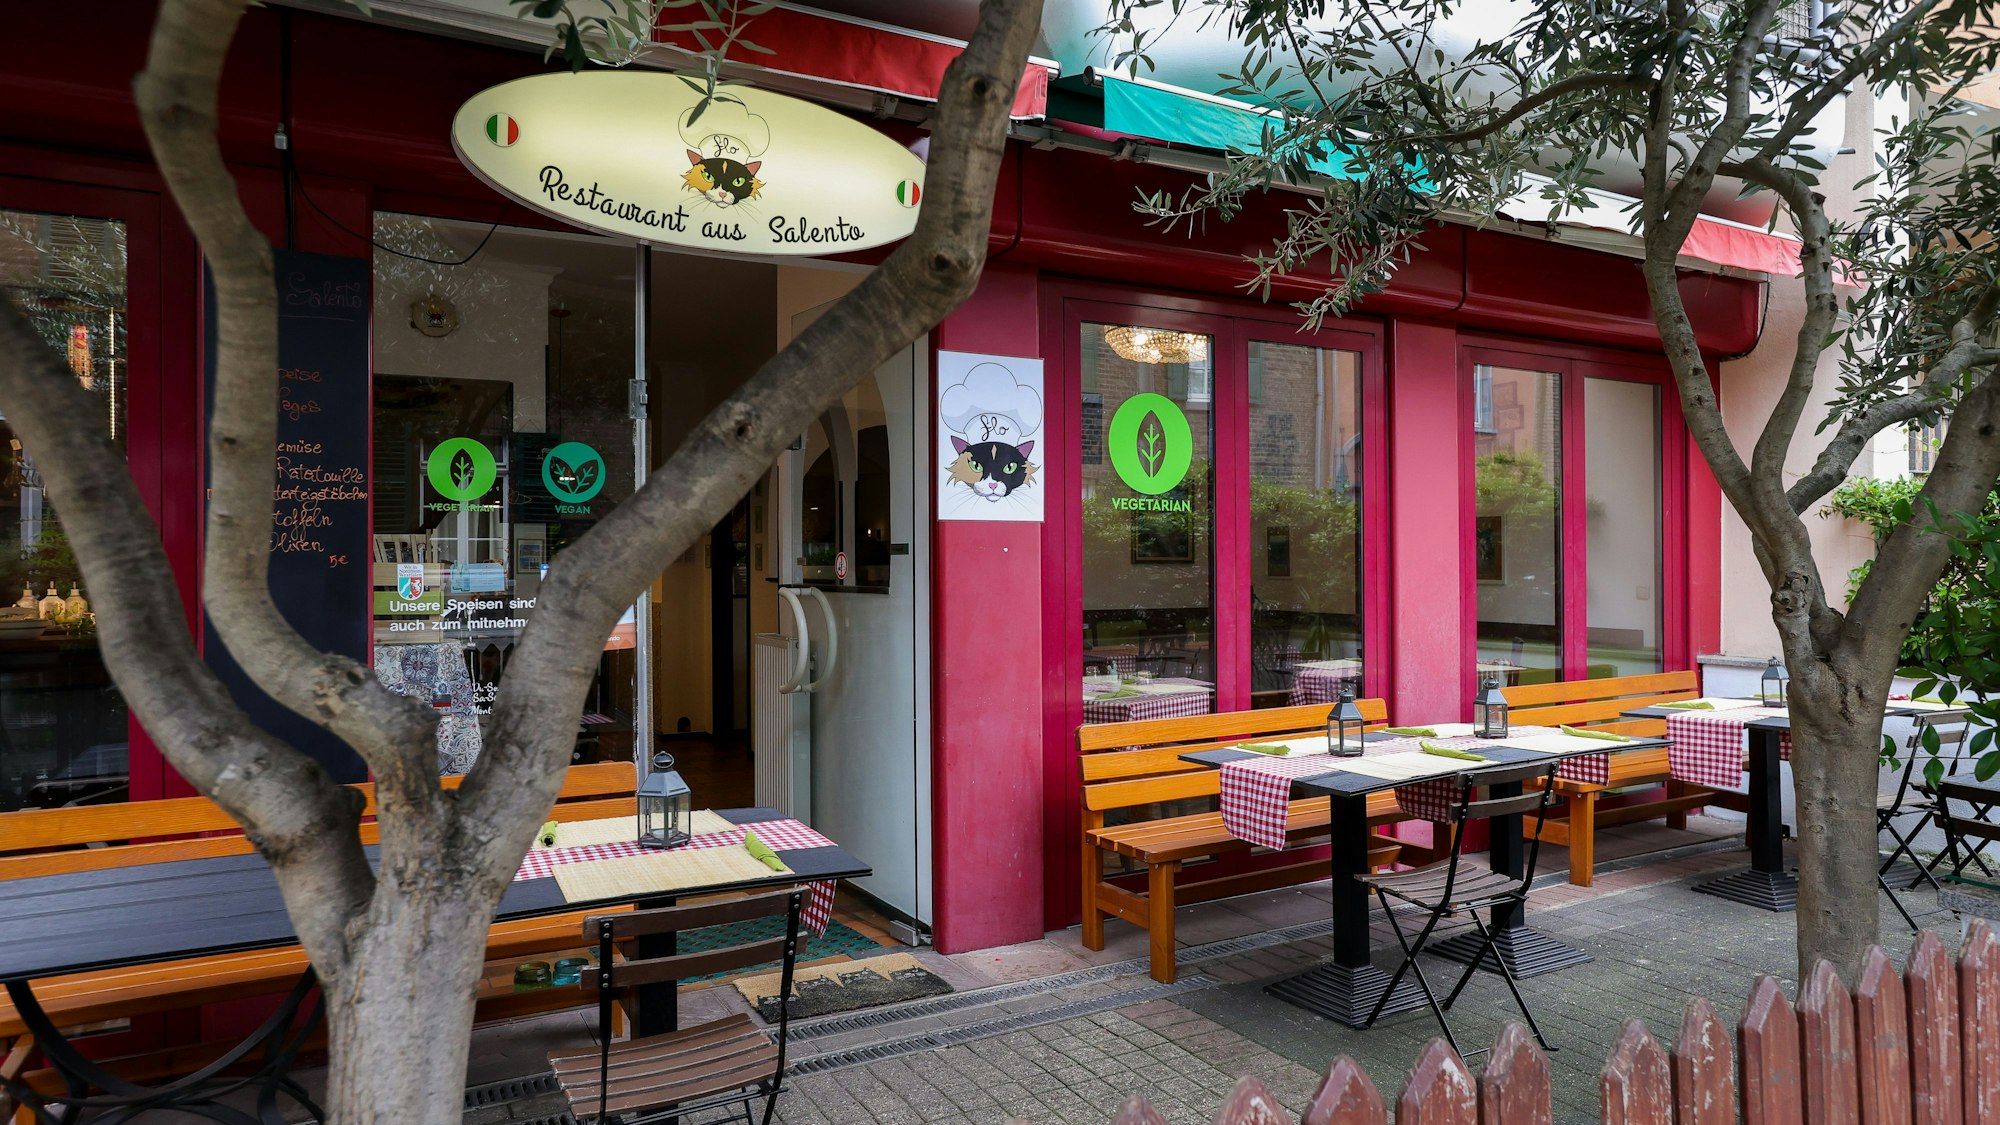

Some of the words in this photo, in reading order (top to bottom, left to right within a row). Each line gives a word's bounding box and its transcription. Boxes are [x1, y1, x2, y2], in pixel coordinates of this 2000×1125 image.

[539, 165, 691, 233] Restaurant
[702, 220, 747, 241] aus
[769, 216, 865, 244] Salento
[286, 272, 362, 309] Salento
[276, 439, 322, 454] emüse
[272, 484, 368, 511] terteigstäbchen
[1111, 497, 1191, 513] VEGETARIAN
[428, 502, 495, 513] VEGETARIAN
[554, 504, 591, 515] VEGAN
[271, 507, 333, 541] toffeln
[389, 600, 441, 612] Unsere
[447, 598, 503, 613] Speisen
[509, 597, 537, 609] sind
[390, 619, 425, 632] auch
[432, 620, 461, 630] zum
[467, 617, 529, 629] mitnehm
[470, 705, 493, 715] Mont
